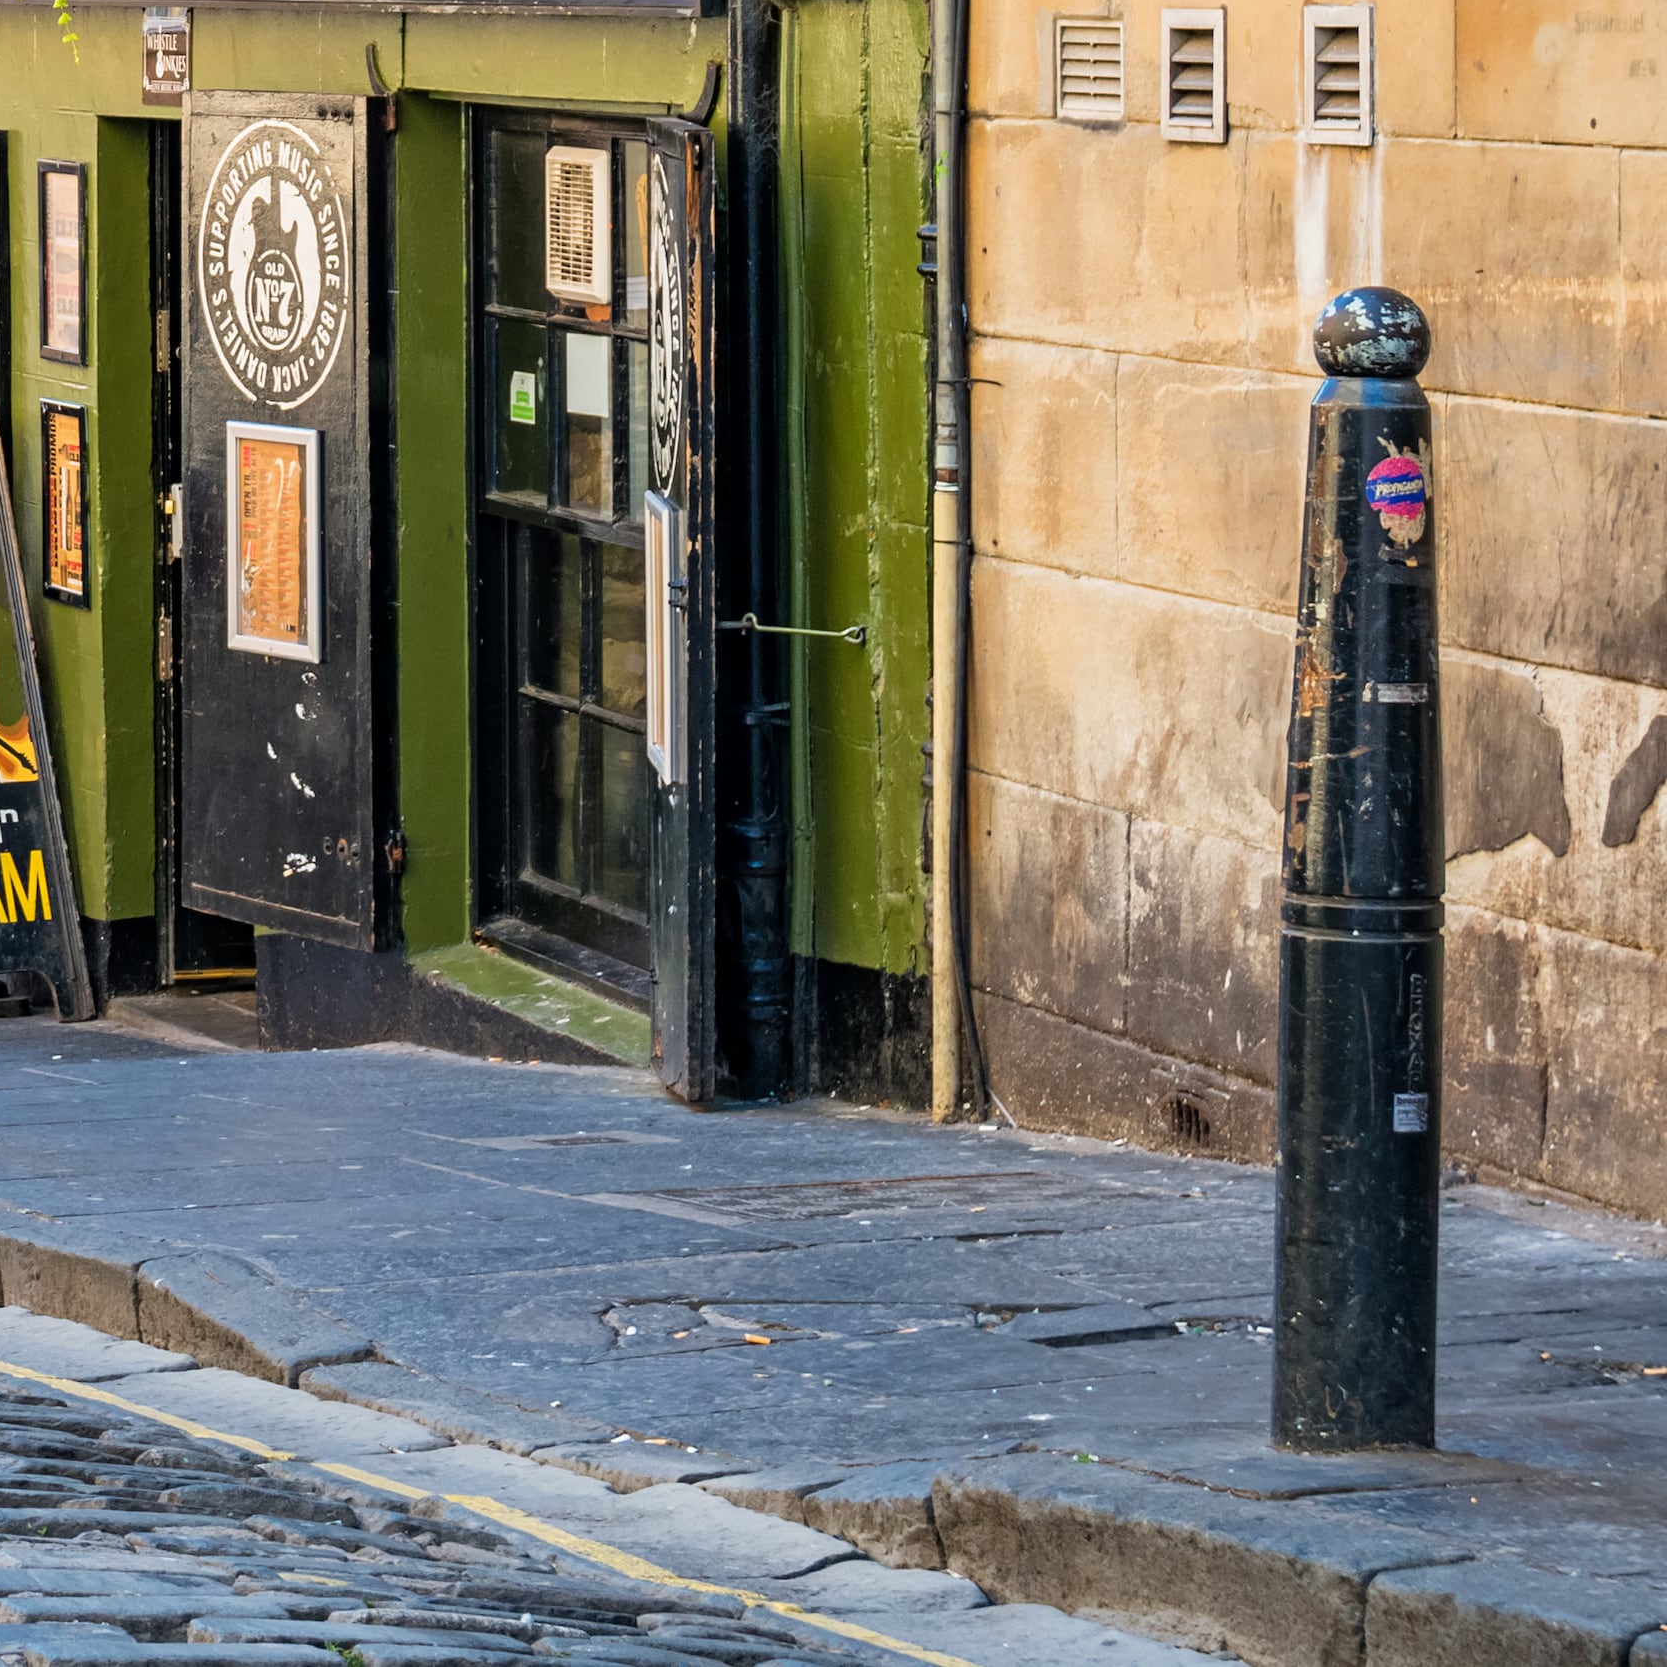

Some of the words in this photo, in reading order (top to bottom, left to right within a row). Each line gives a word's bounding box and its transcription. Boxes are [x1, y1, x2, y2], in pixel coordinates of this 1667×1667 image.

[278, 140, 323, 202] MUSIC
[209, 140, 272, 277] SUPPORTING
[264, 260, 285, 276] OLD
[318, 205, 341, 290] SINCE
[212, 287, 267, 390] DANIEL'S
[261, 326, 289, 341] BRAND
[312, 296, 338, 361] 1892
[272, 356, 310, 394] JACK
